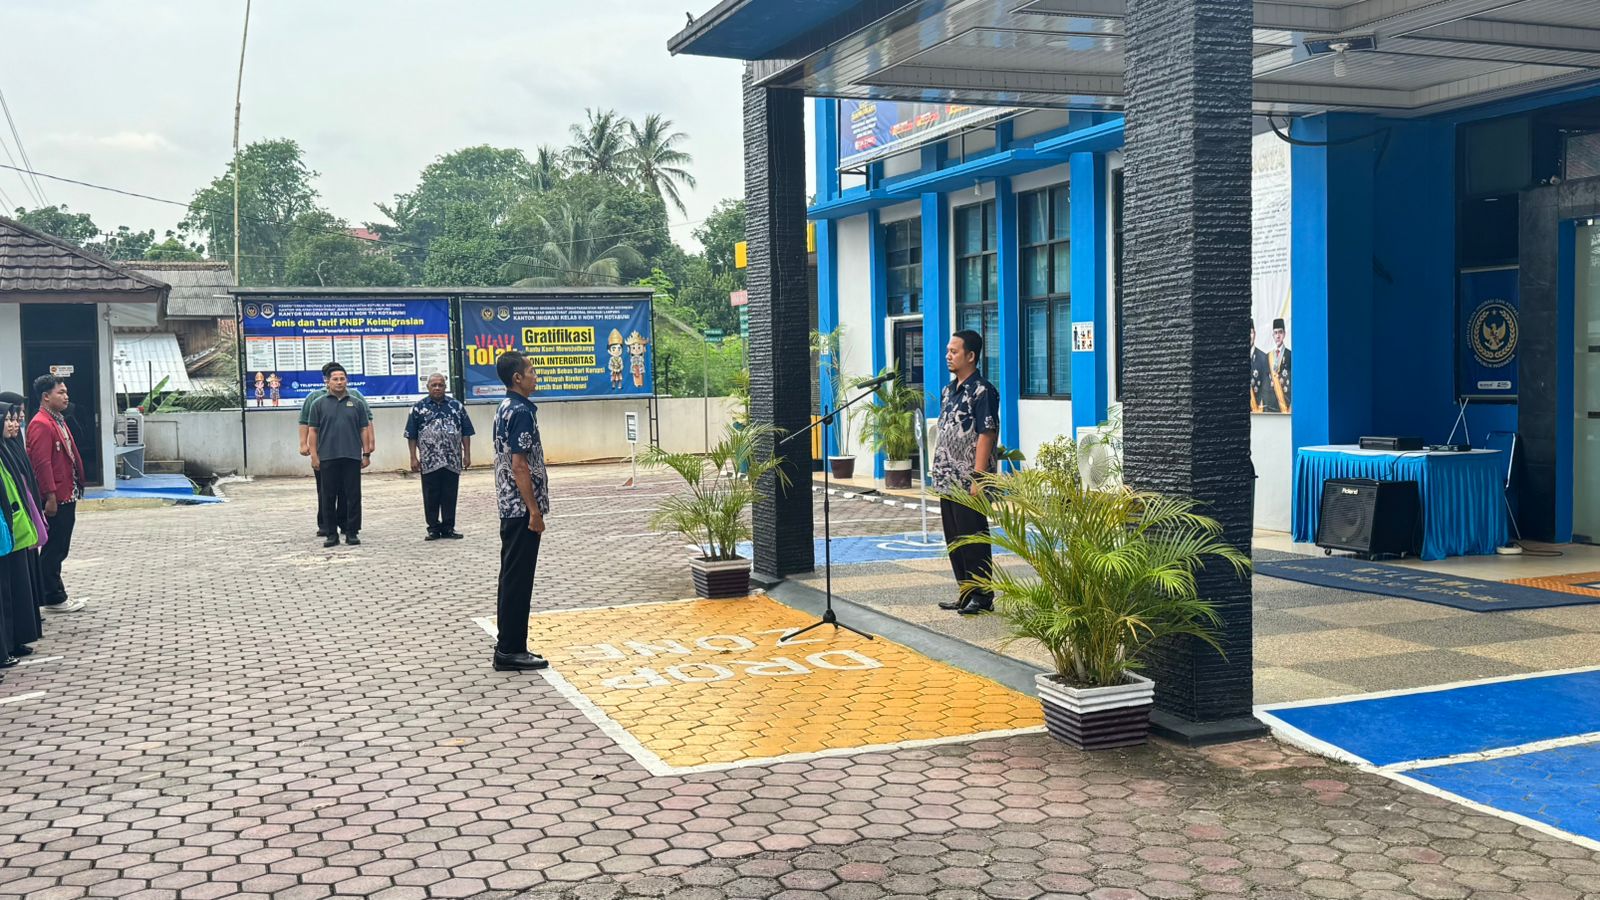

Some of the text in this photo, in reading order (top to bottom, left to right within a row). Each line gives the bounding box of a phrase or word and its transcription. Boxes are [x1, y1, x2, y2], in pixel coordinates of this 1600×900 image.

[272, 317, 424, 327] Jenis dan Tarif PNBP Keimigrasian
[525, 329, 592, 344] Gratifikasi
[548, 356, 594, 365] INTERGRITAS
[1341, 487, 1358, 495] Roland
[601, 650, 884, 690] DROP
